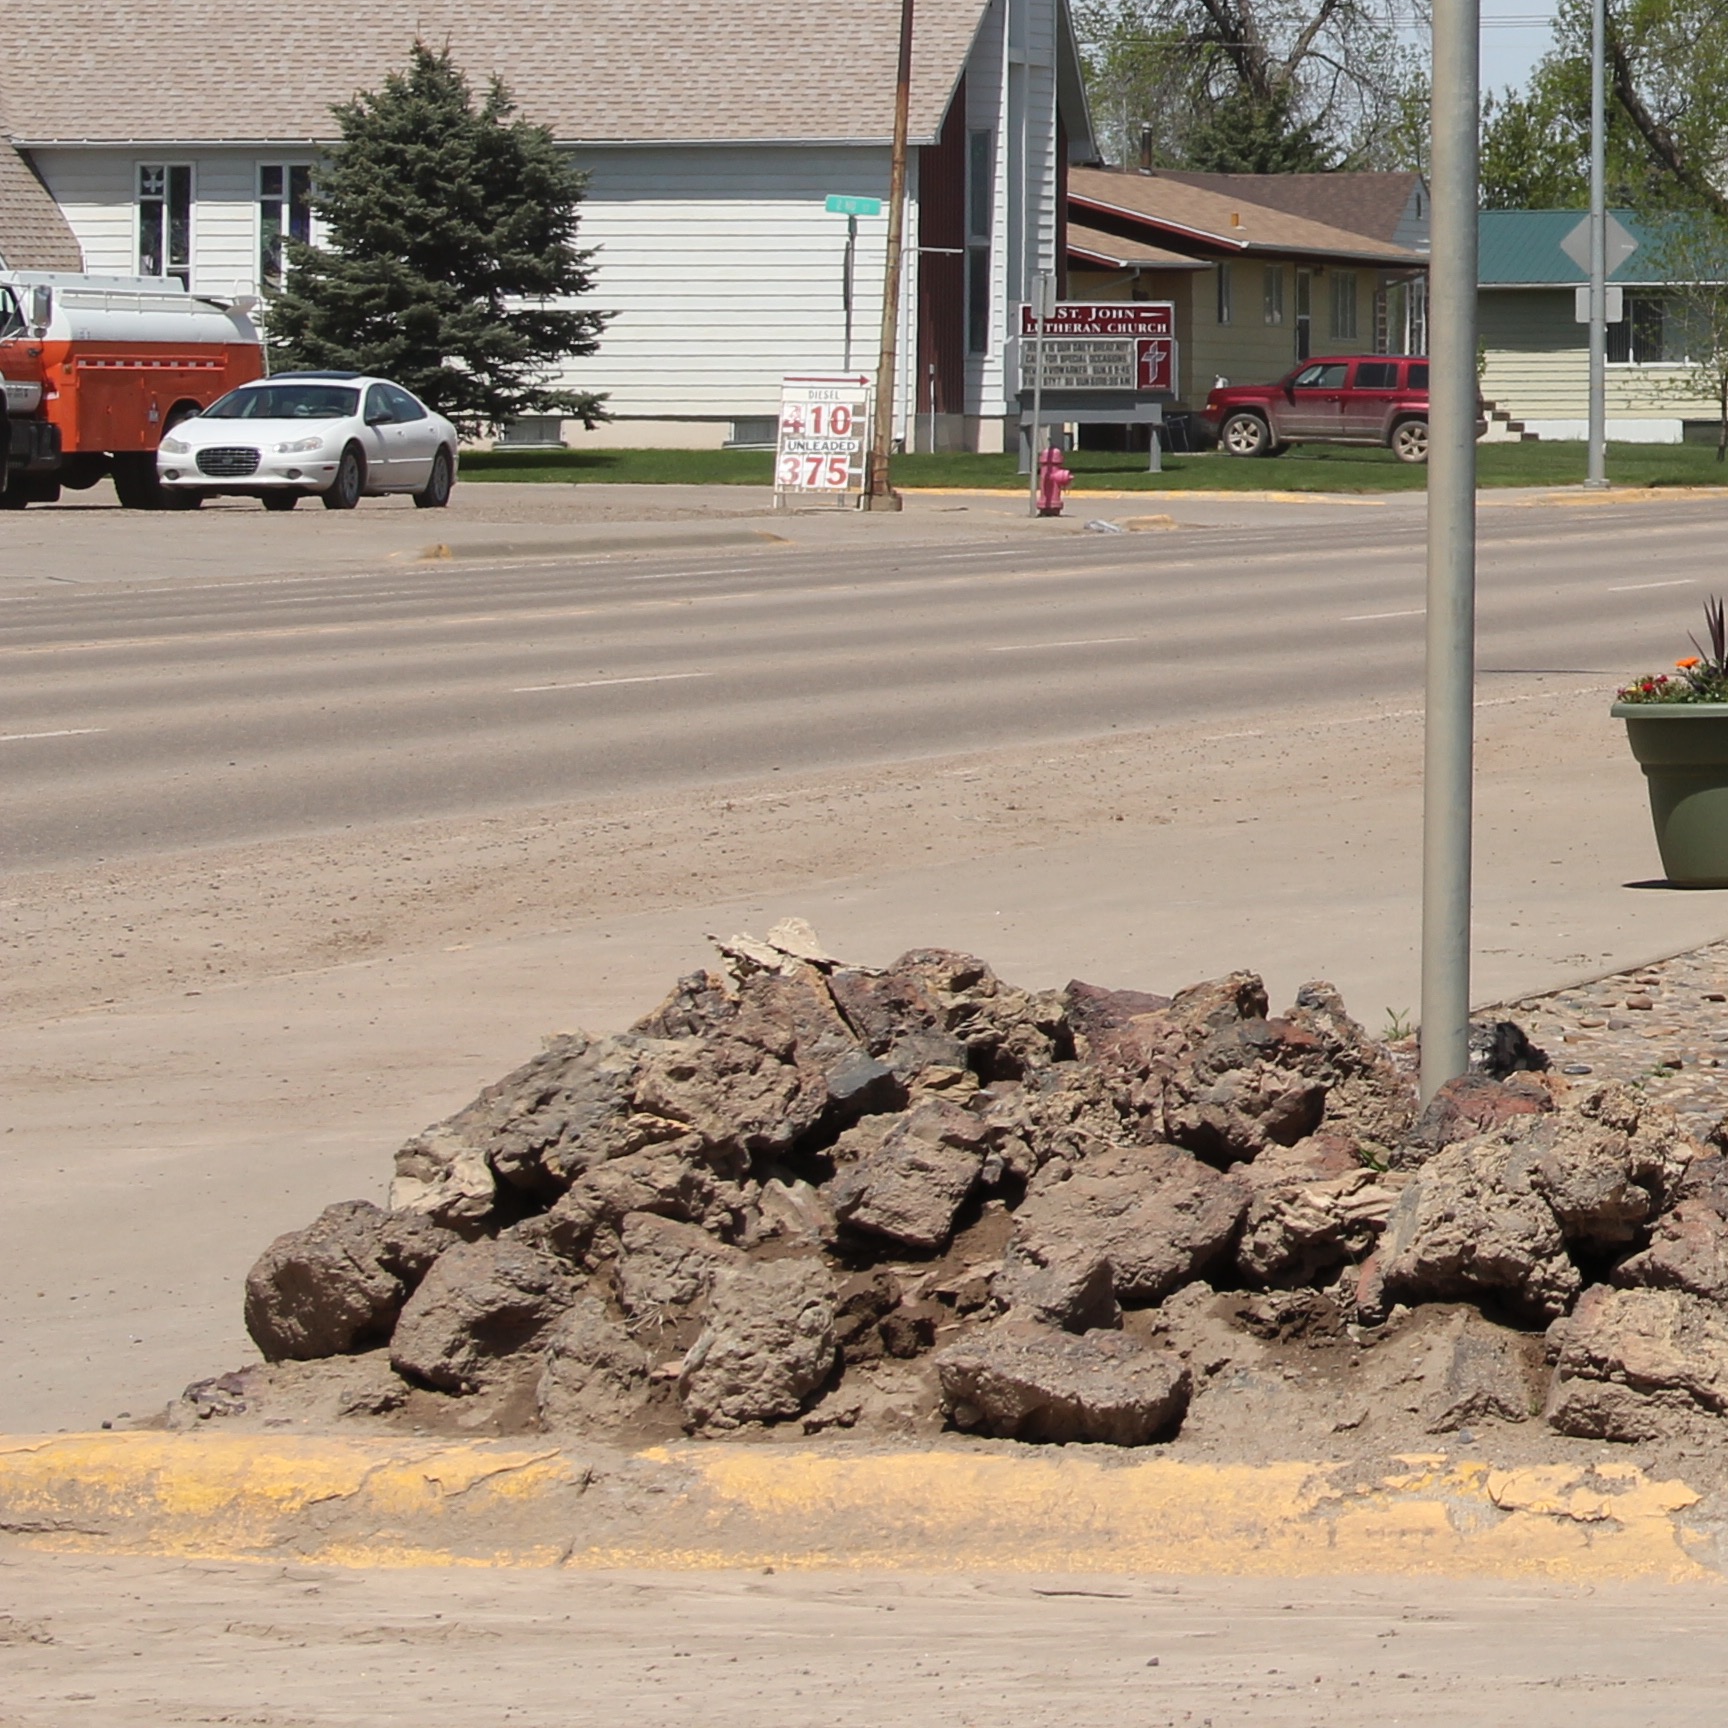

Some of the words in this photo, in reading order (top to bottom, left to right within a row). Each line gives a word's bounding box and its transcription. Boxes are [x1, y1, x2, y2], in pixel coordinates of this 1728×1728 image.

[1088, 307, 1135, 321] JOHN
[1107, 322, 1167, 333] CHURCH
[808, 390, 840, 400] DIESEL
[787, 441, 856, 451] UNLEADED
[779, 457, 848, 486] 375
